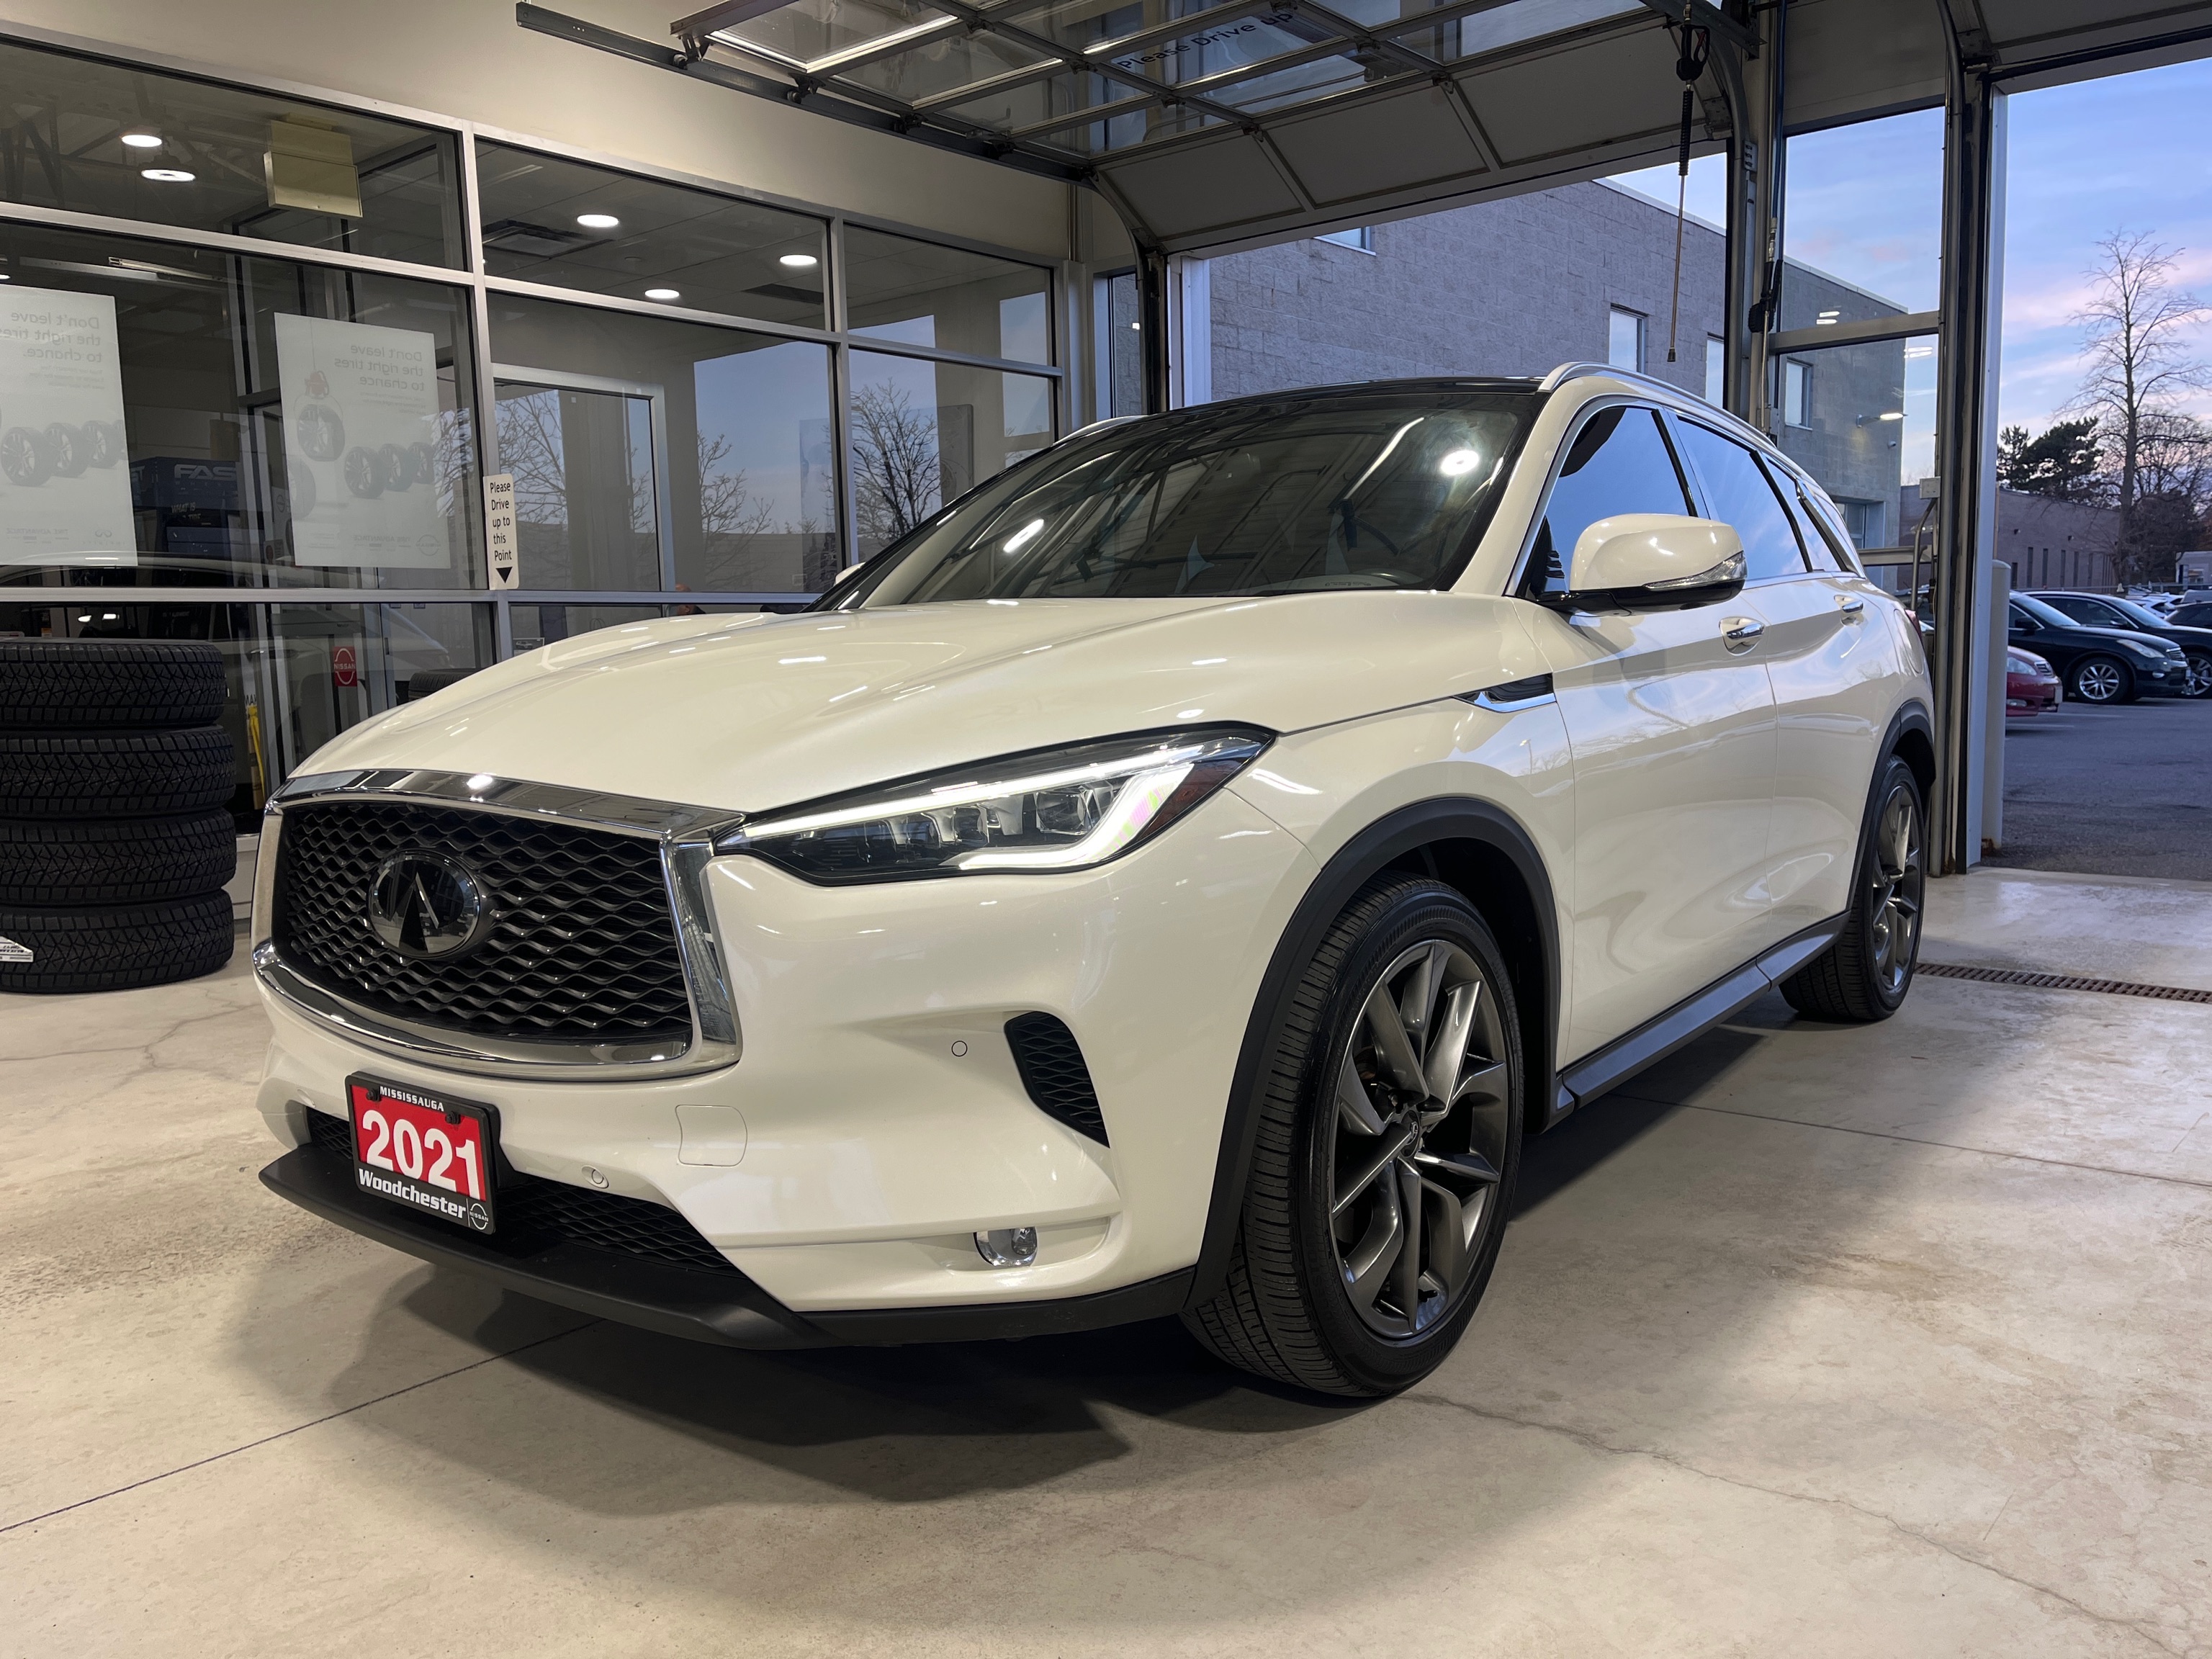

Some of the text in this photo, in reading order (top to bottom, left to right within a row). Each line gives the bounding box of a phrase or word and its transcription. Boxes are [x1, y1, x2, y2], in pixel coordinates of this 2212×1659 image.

[1117, 13, 1294, 68] Please Drive up
[490, 482, 511, 493] Please
[491, 498, 509, 511] Drive
[493, 516, 511, 529] up to
[493, 532, 506, 544] this
[495, 549, 512, 561] Point
[379, 1086, 444, 1112] MISSISSAUGA
[362, 1110, 480, 1200] 2021
[359, 1168, 467, 1218] Woodchester
[469, 1210, 489, 1222] NISSAN
